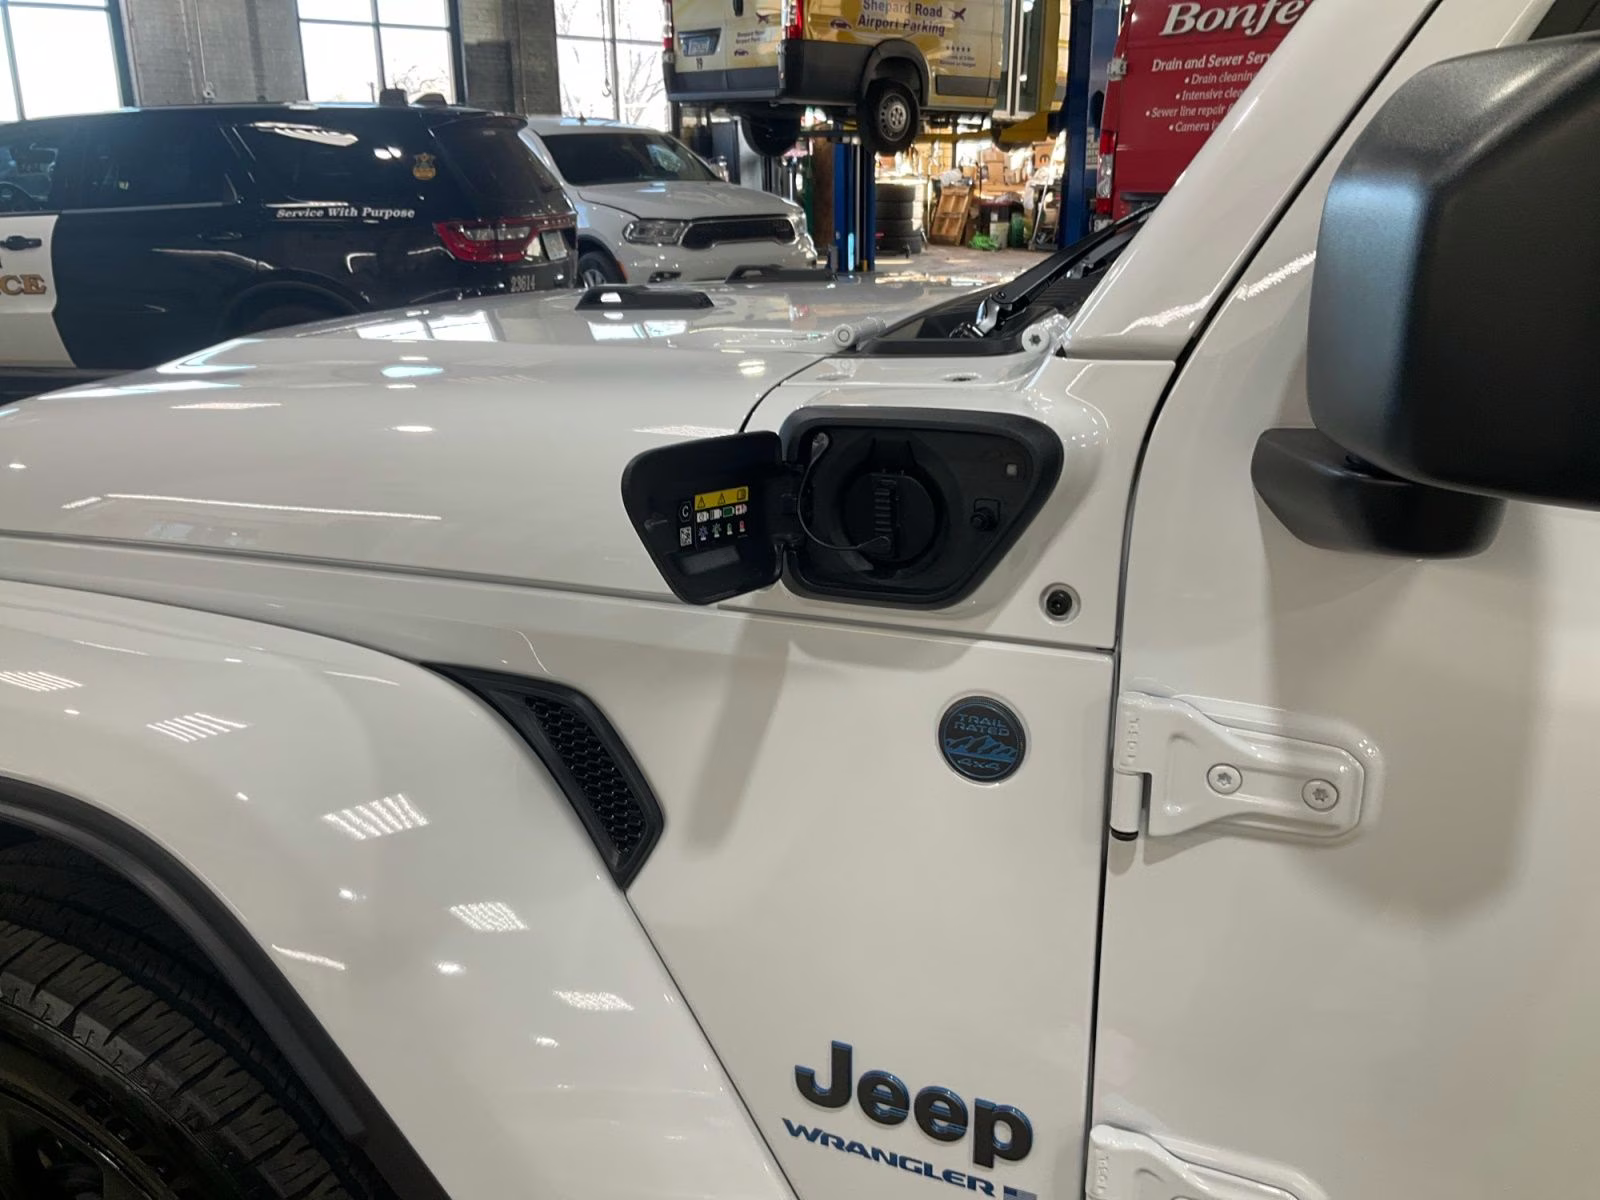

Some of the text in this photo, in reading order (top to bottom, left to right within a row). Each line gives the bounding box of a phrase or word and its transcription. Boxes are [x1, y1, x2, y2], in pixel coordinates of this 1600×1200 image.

[863, 0, 943, 18] Shepard Road
[858, 14, 945, 37] Airport Parking
[1158, 0, 1303, 37] Bonfe
[1151, 57, 1182, 72] Drain
[1184, 56, 1206, 71] and
[1207, 53, 1244, 68] Sewer
[1191, 71, 1217, 85] Drain
[1181, 87, 1223, 101] Intensive
[1151, 106, 1178, 119] Sewer
[1180, 104, 1196, 117] line
[1198, 103, 1225, 118] repair
[1175, 120, 1210, 133] Camera
[276, 207, 416, 220] Service With Purpose
[954, 721, 1010, 737] RATED
[957, 713, 1008, 729] TRAIL
[794, 1040, 1034, 1169] Jeep
[782, 1117, 997, 1198] WRANGLER
